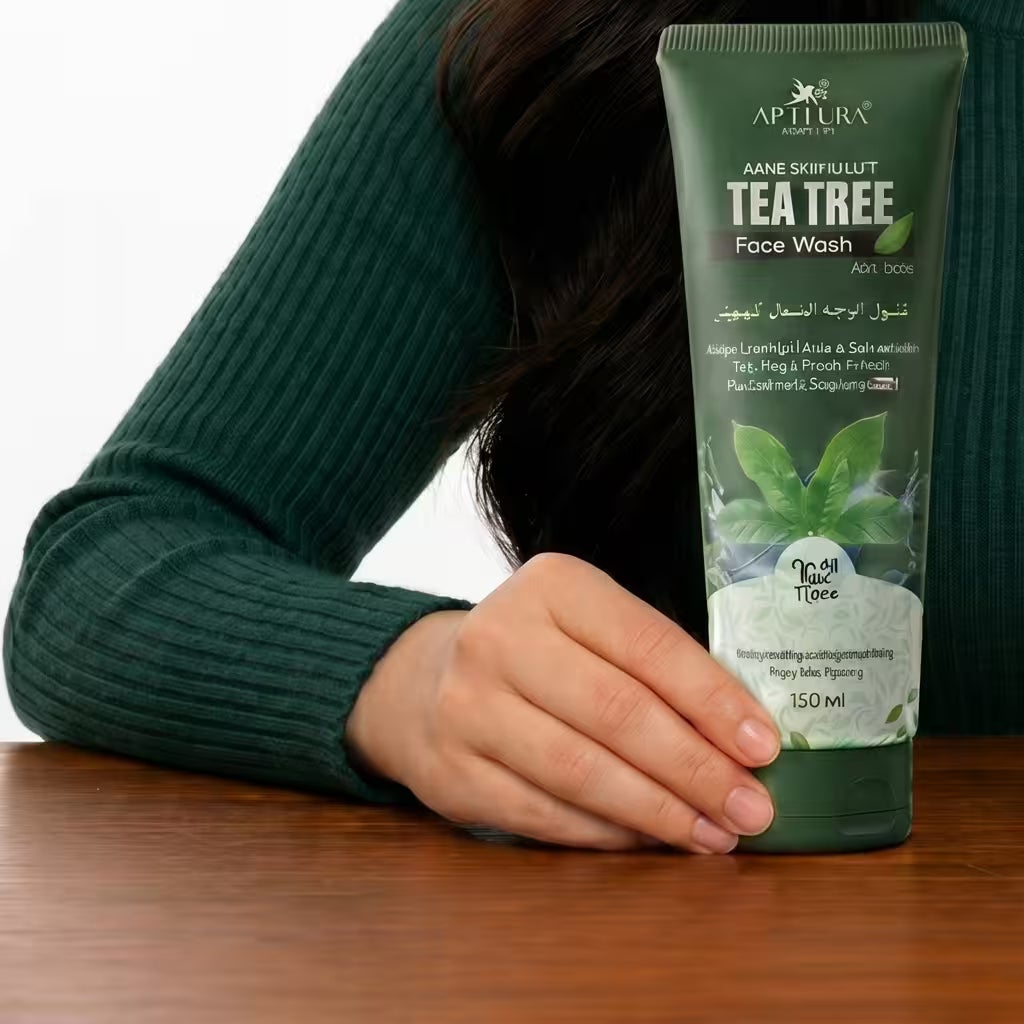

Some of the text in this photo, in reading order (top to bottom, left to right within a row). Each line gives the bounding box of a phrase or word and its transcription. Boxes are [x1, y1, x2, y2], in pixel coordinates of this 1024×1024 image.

[727, 181, 894, 226] TEA TREE
[736, 236, 852, 254] Face Wash
[790, 692, 821, 708] 150
